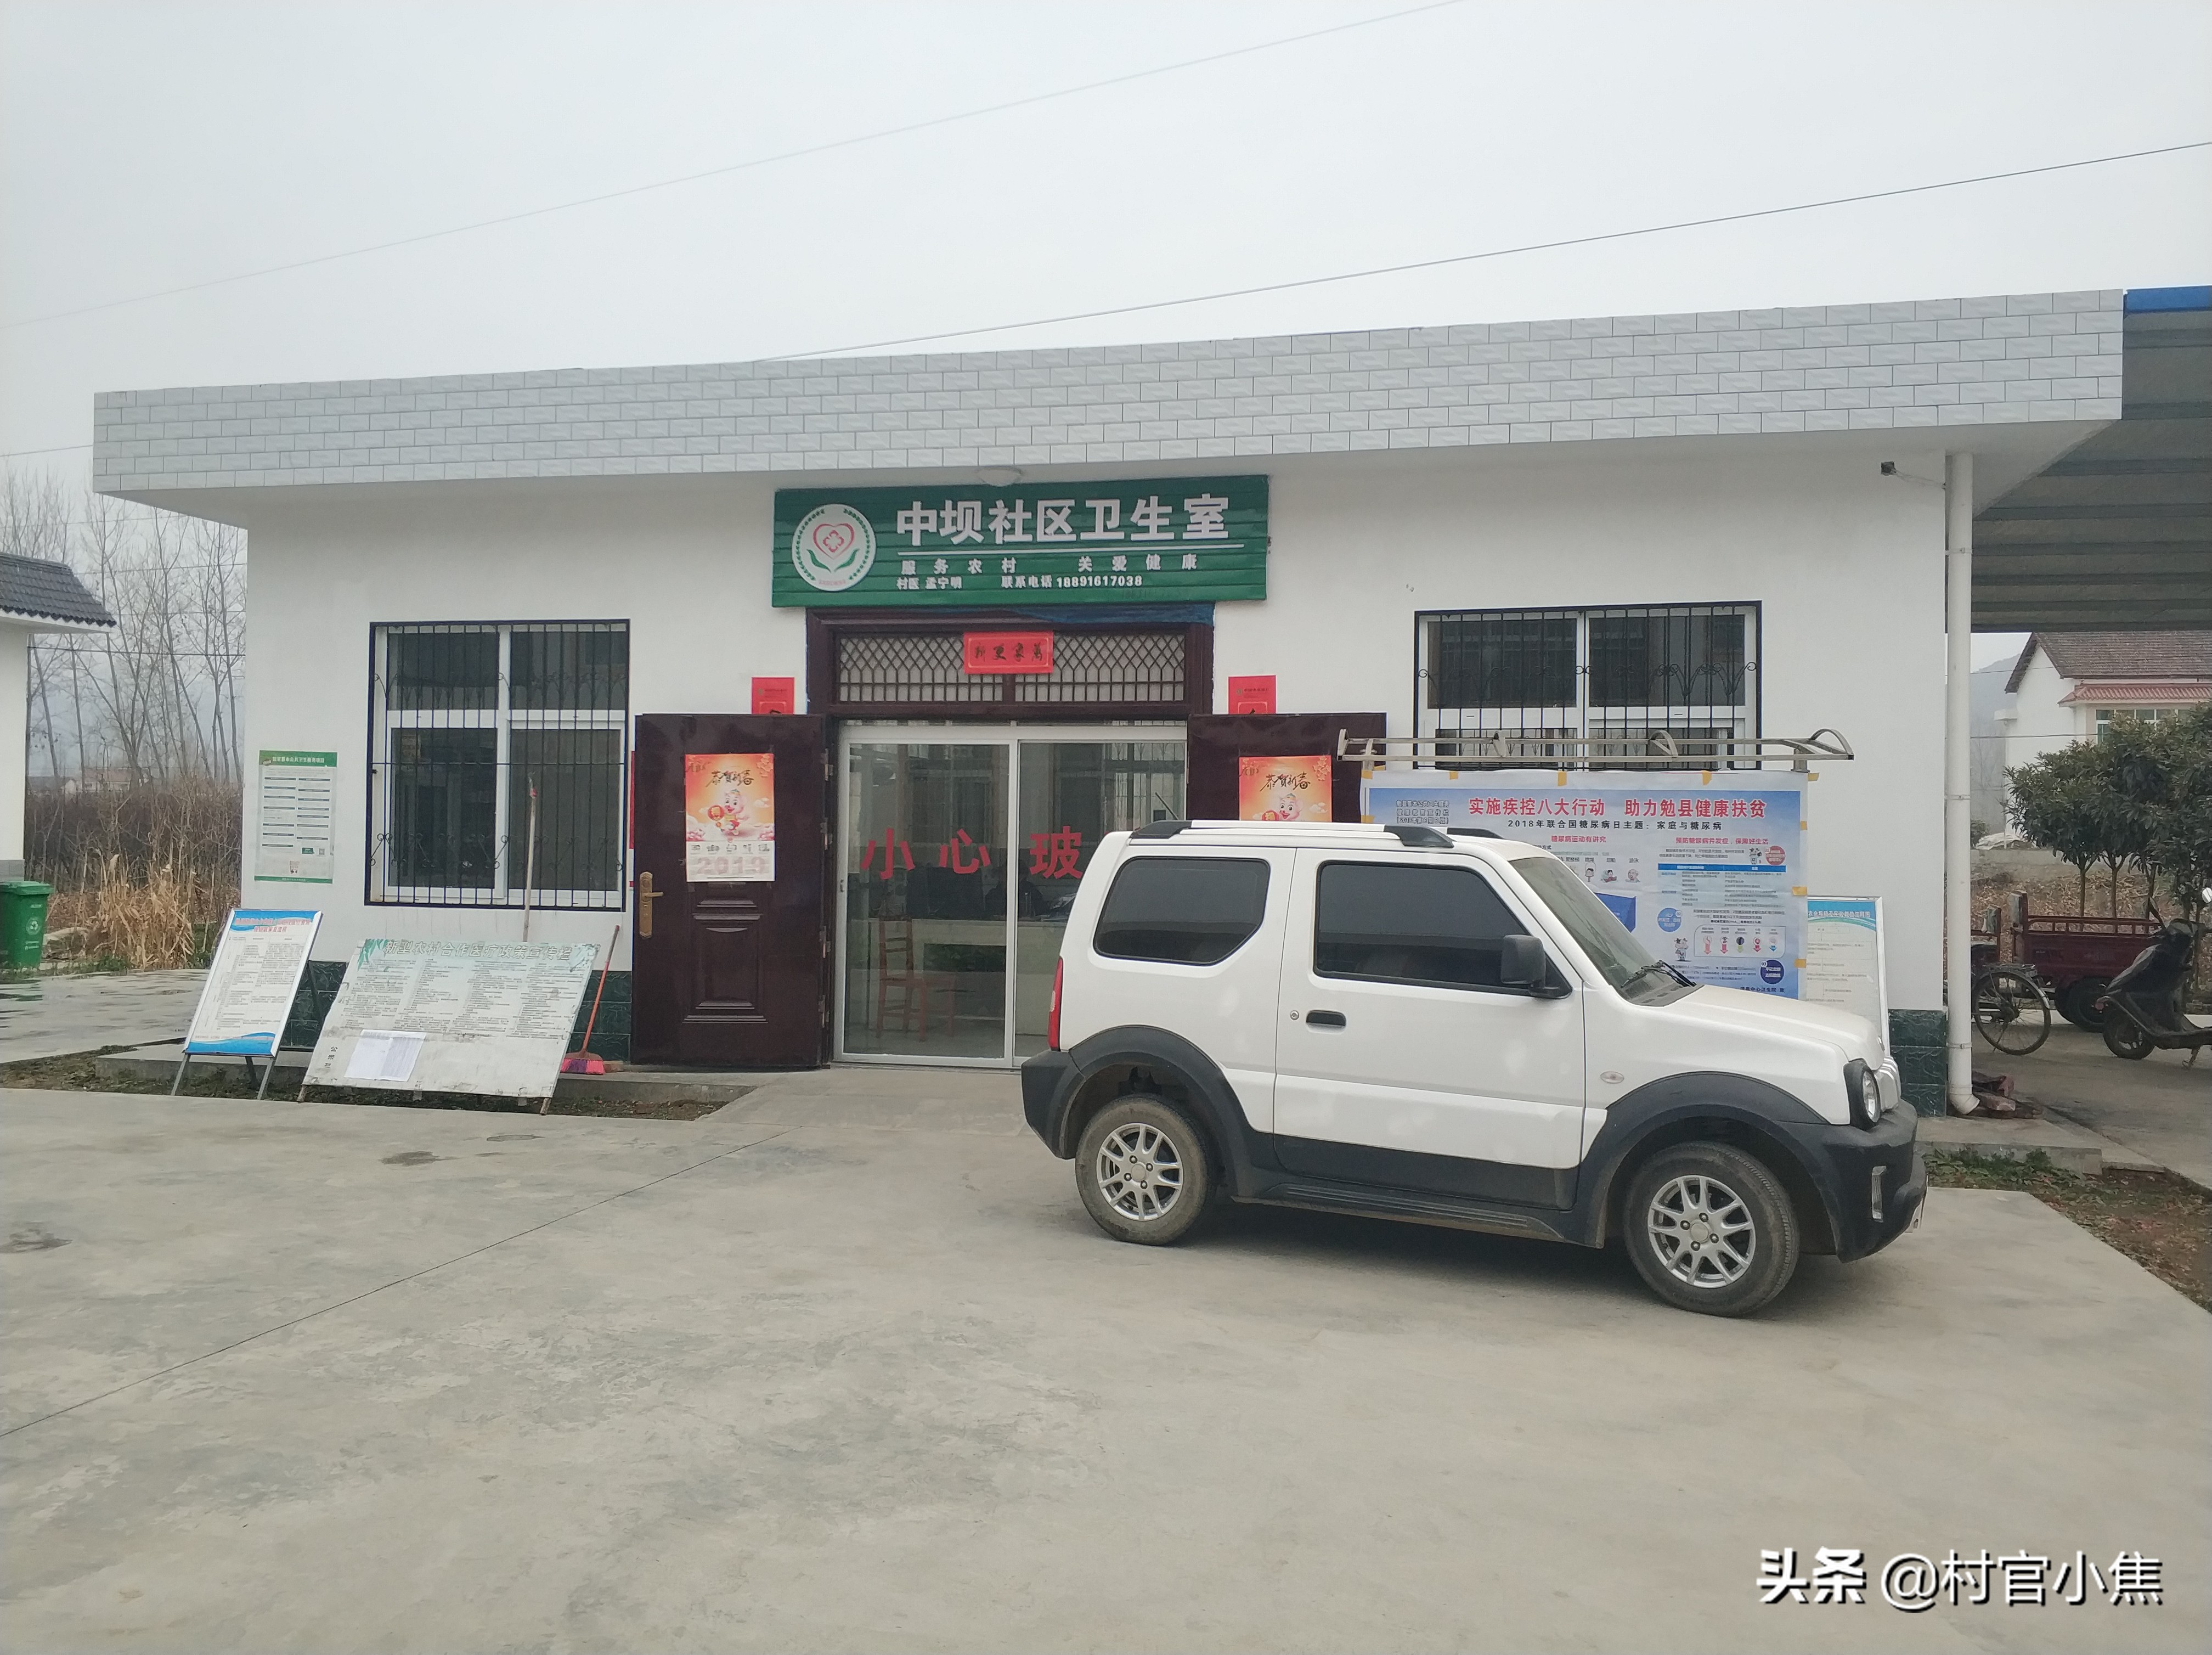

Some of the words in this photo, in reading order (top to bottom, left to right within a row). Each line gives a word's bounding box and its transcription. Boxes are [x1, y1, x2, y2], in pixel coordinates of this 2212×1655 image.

[896, 493, 1229, 547] 中坝社区卫生室
[901, 557, 1016, 576] 服务农村
[1078, 554, 1198, 572] 关爱健康
[1056, 575, 1143, 588] 18891617038
[1469, 797, 1605, 817] 实施疾控八大行动
[1624, 798, 1767, 818] 助力勉县健康扶贫
[860, 826, 1083, 880] 小心玻
[385, 940, 572, 960] 新型农村合作医疗政策宣传栏
